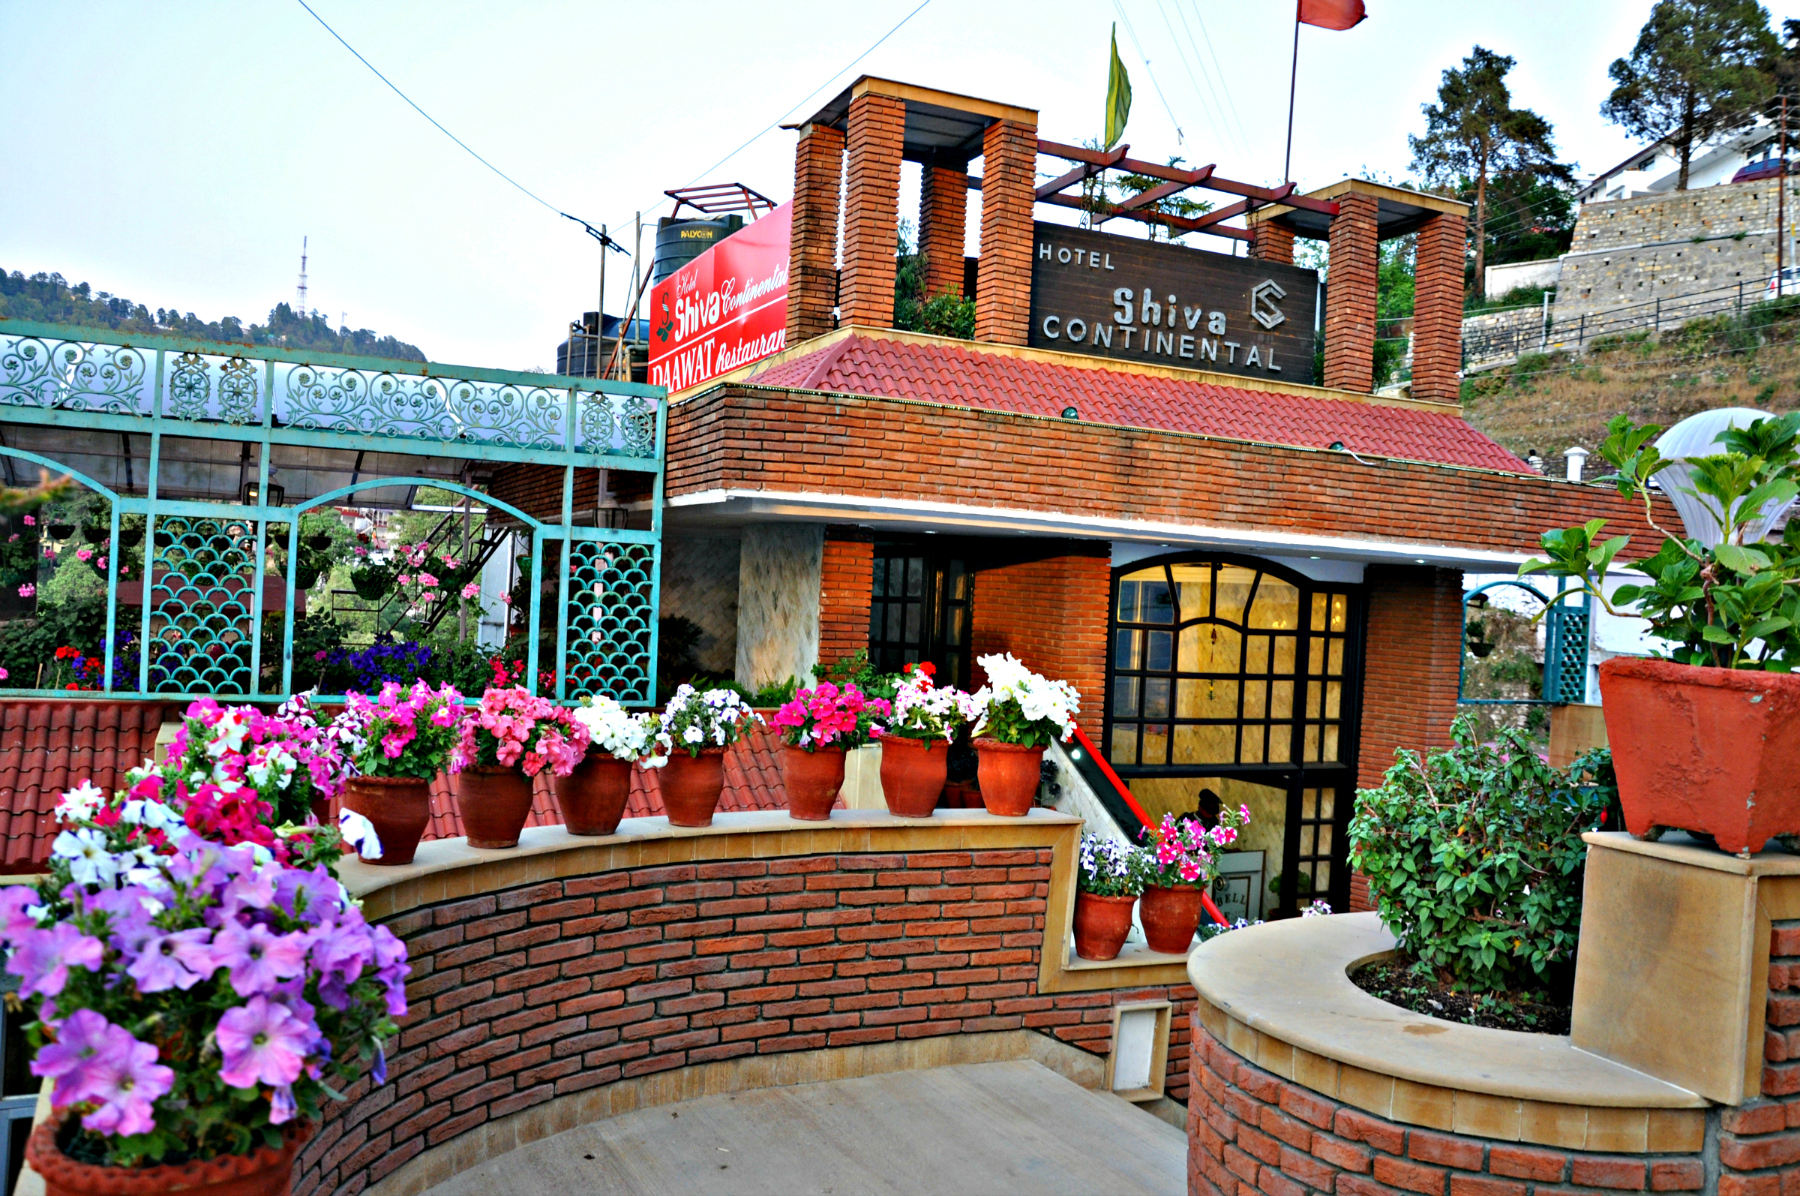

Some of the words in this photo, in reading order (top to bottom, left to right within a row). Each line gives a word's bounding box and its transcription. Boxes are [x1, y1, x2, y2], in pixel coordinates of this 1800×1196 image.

[1039, 243, 1115, 270] HOTEL
[675, 290, 720, 342] Shiva
[721, 256, 791, 317] Continental
[676, 268, 699, 299] Hotel
[1113, 287, 1227, 336] Shiva
[652, 336, 716, 393] DAAWAT
[714, 328, 787, 375] Restauran
[1042, 315, 1282, 372] CONTINENTAL
[1216, 892, 1247, 908] BELL
